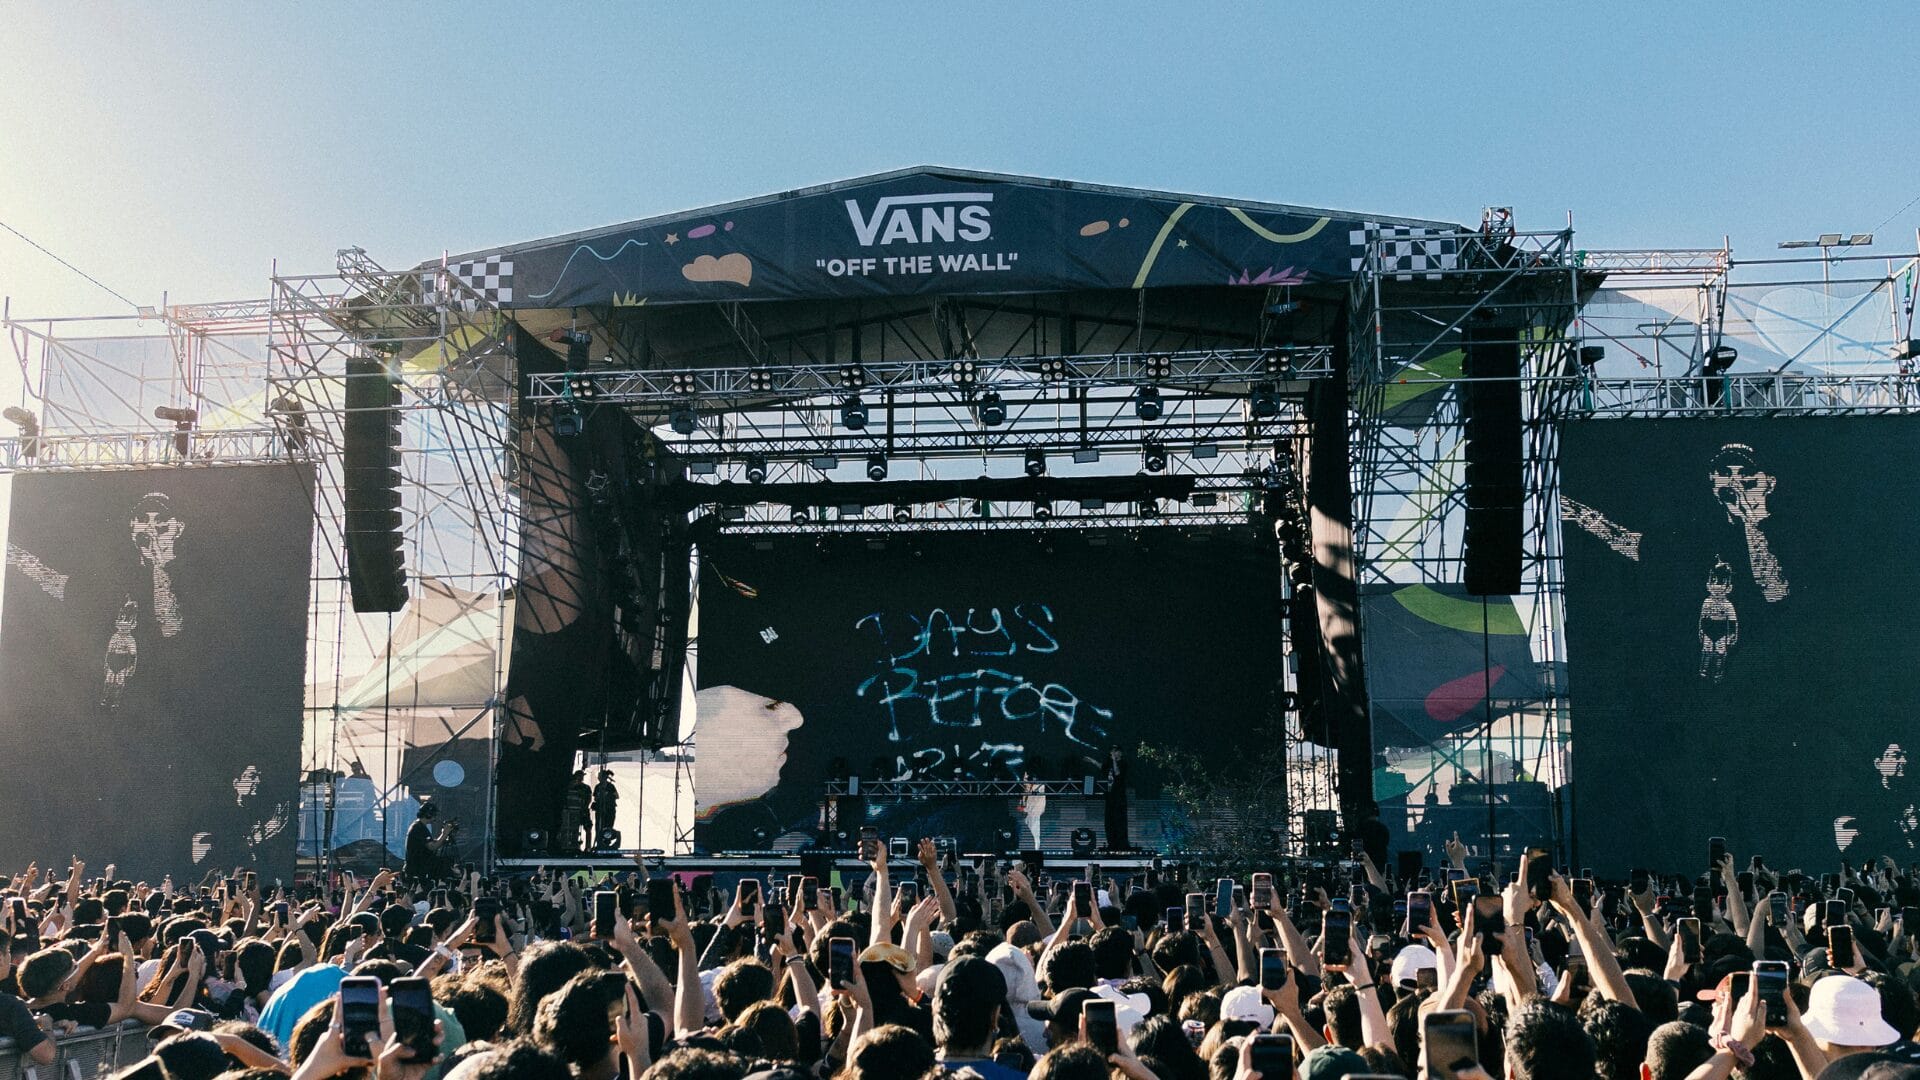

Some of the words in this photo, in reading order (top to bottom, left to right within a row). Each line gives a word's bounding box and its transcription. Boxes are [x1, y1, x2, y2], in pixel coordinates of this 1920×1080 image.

[845, 193, 994, 246] VANS
[816, 259, 876, 276] "OFF
[883, 255, 932, 275] THE
[938, 252, 1018, 273] WALL"
[855, 601, 1059, 666] DAYS
